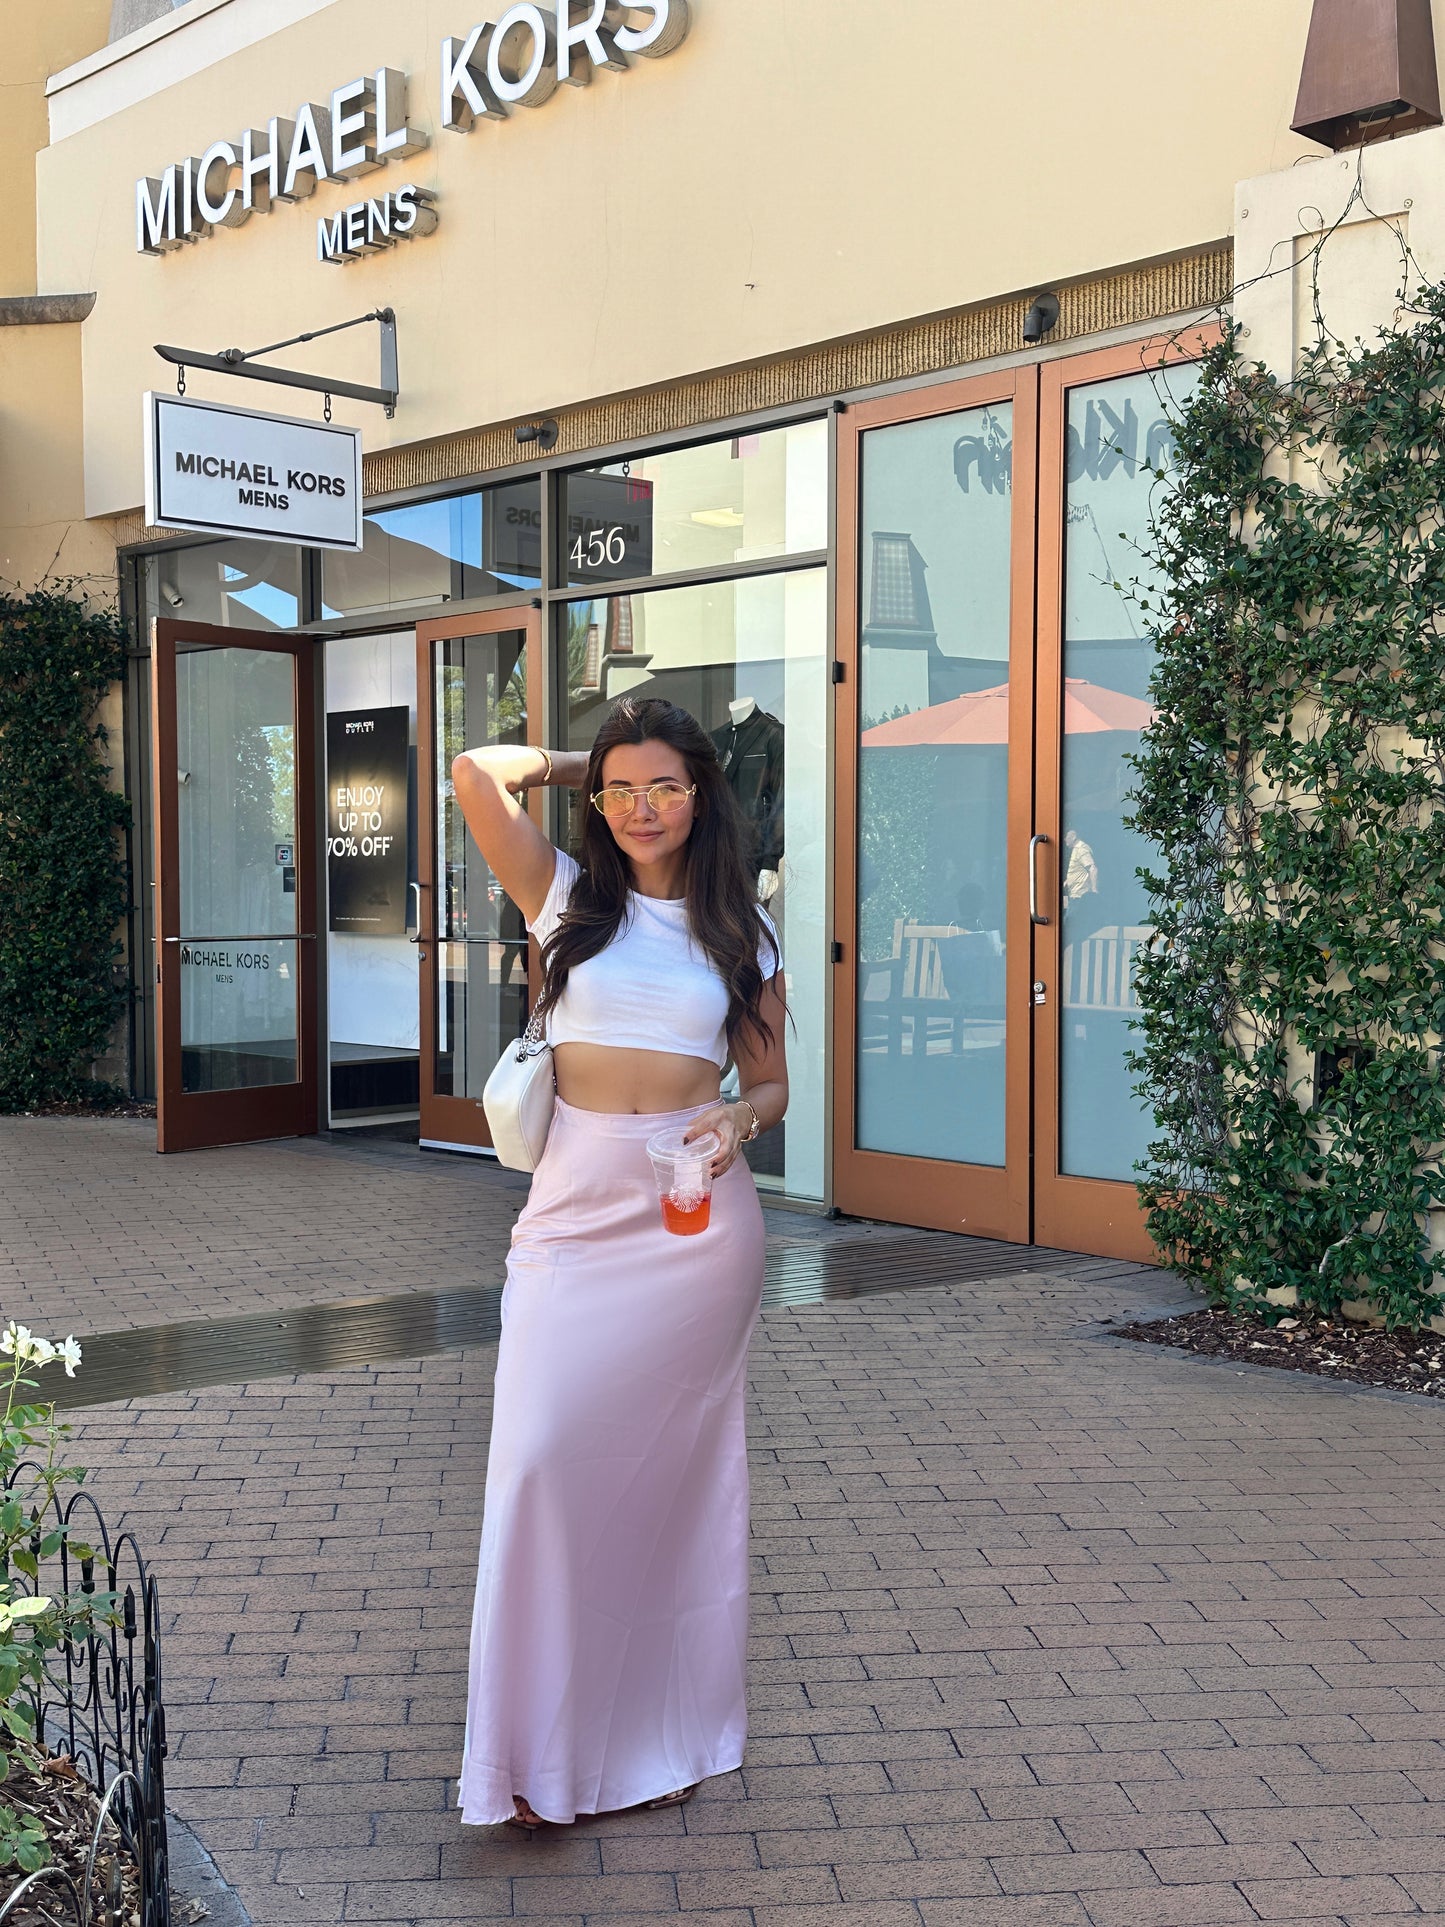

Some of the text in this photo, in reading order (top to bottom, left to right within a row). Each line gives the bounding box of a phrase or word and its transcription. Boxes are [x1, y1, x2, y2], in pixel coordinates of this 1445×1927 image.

[136, 0, 670, 254] MICHAEL KORS
[316, 183, 418, 262] MENS
[175, 451, 346, 497] MICHAEL KORS
[238, 487, 289, 510] MENS
[569, 526, 626, 569] 456
[336, 785, 384, 808] ENJOY
[338, 811, 382, 832] UP TO
[327, 837, 358, 857] 70%
[181, 950, 270, 970] MICHAEL KORS
[215, 974, 234, 984] MENS
